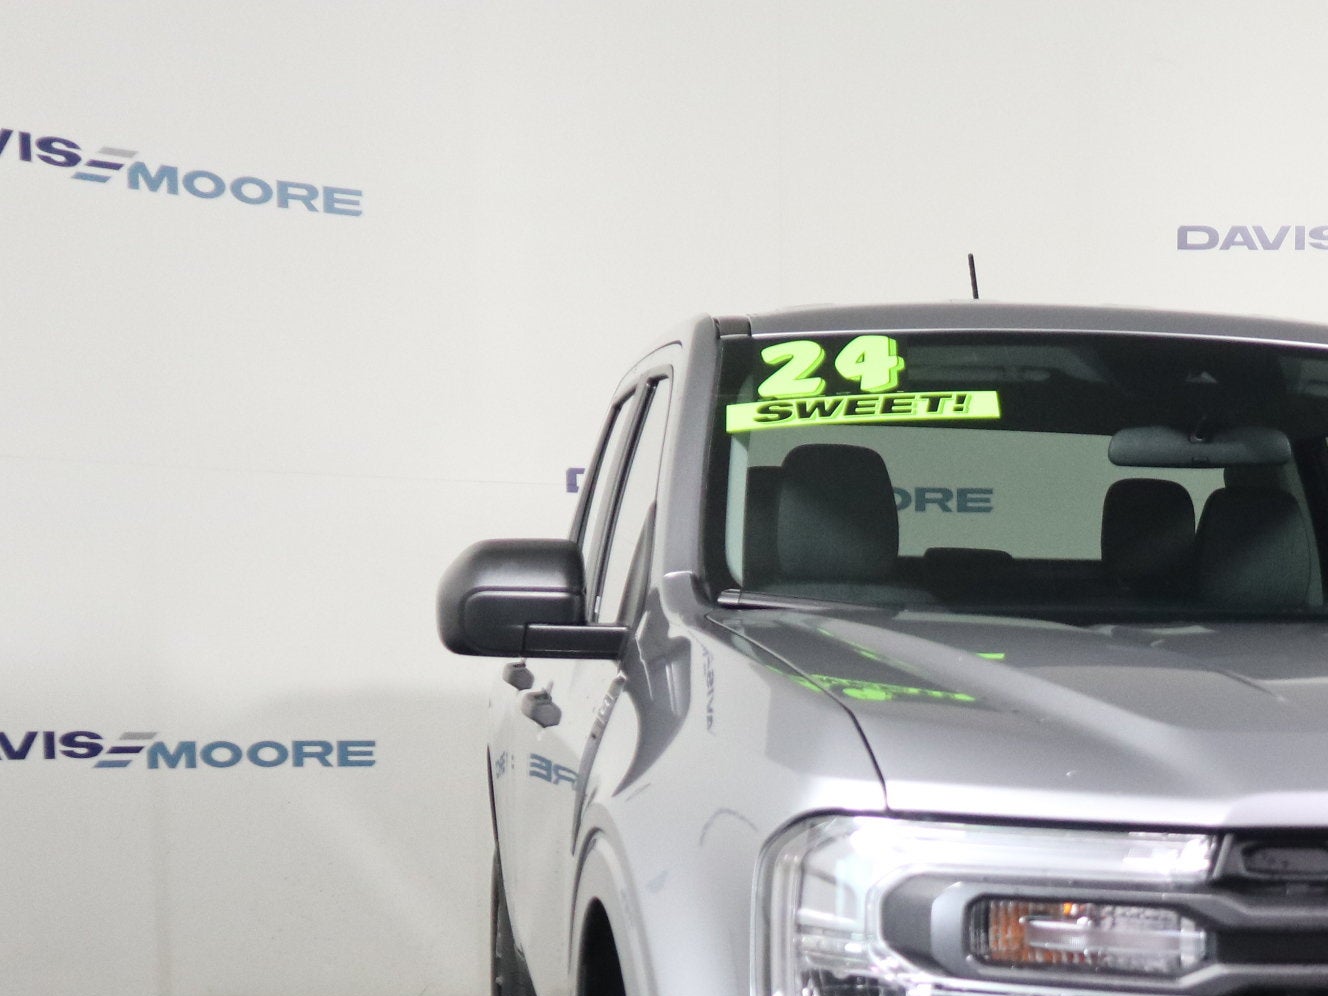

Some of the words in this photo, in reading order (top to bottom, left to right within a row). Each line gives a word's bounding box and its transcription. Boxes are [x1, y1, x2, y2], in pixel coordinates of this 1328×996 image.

[127, 161, 363, 216] MOORE
[758, 335, 905, 398] 24
[753, 394, 973, 422] SWEET!
[147, 740, 376, 769] MOORE
